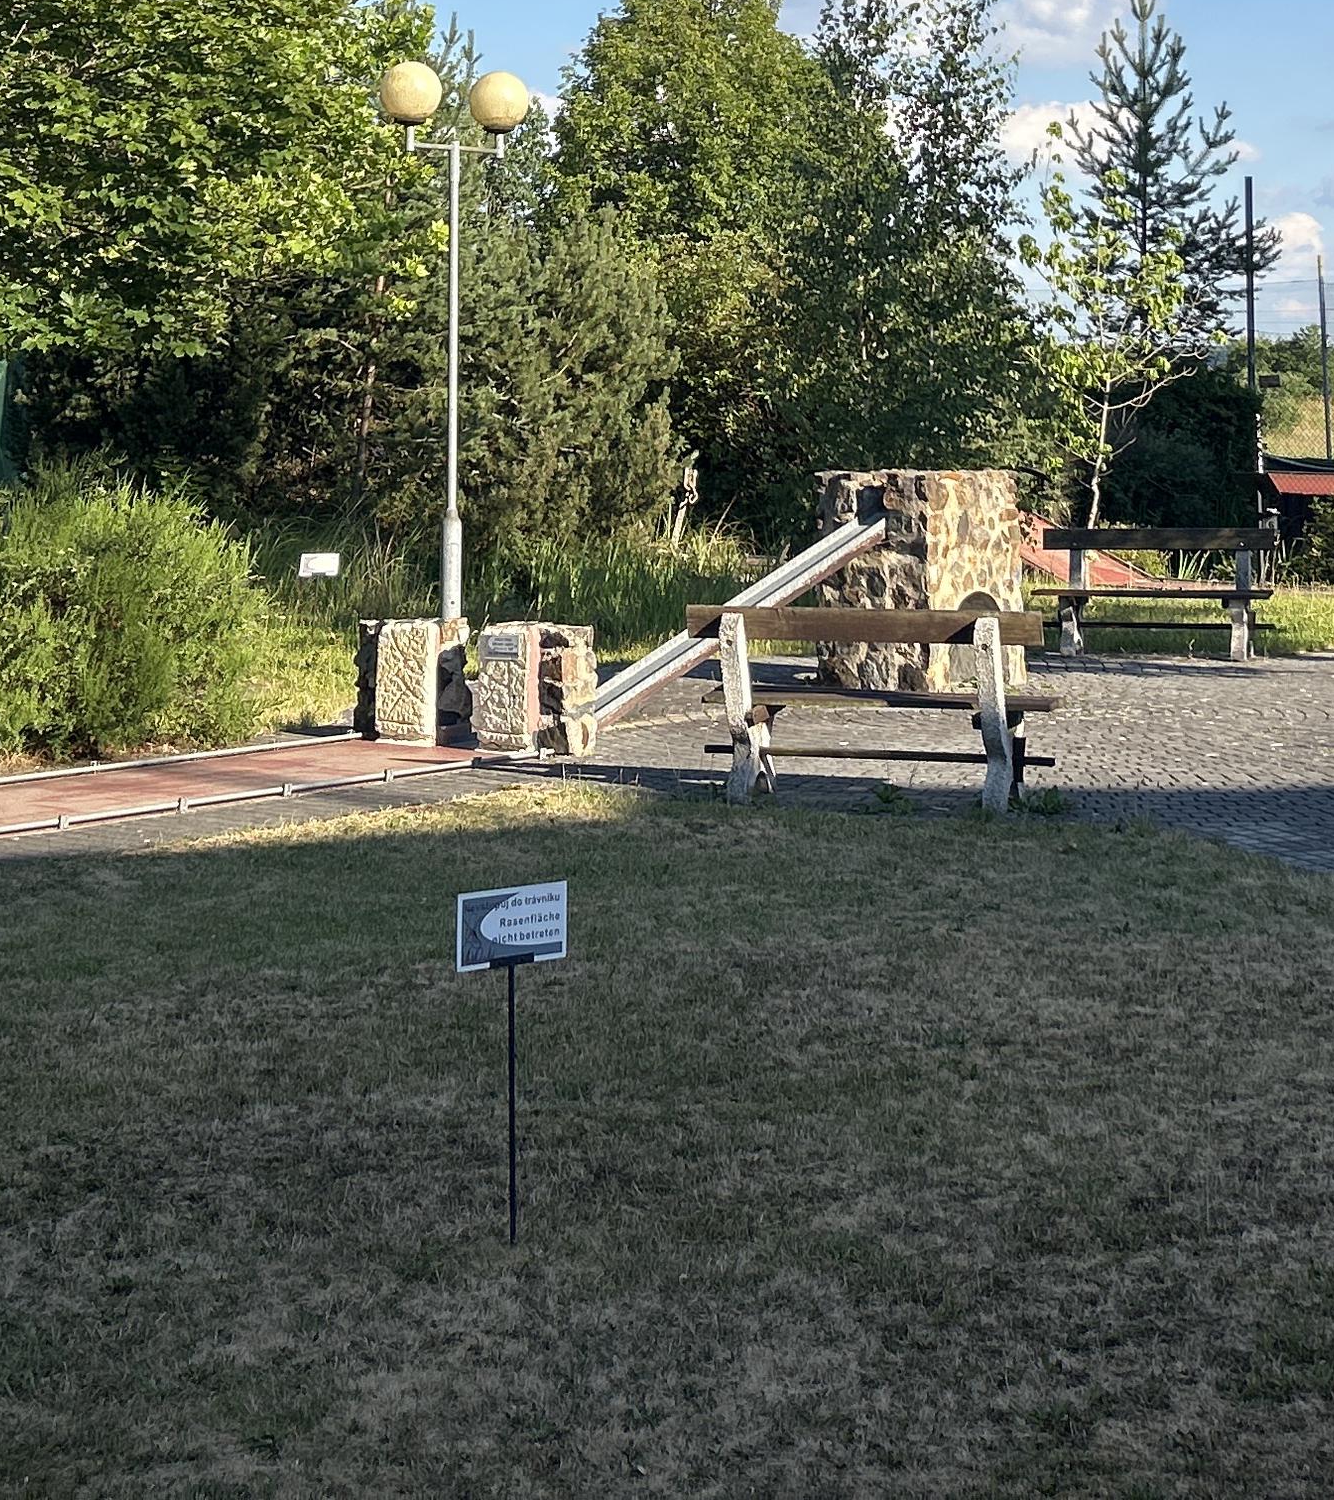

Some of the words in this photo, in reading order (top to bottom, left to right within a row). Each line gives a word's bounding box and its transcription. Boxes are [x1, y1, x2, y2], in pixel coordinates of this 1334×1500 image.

[511, 897, 523, 907] do
[499, 912, 560, 928] Rasenfläche
[519, 927, 560, 941] betreten
